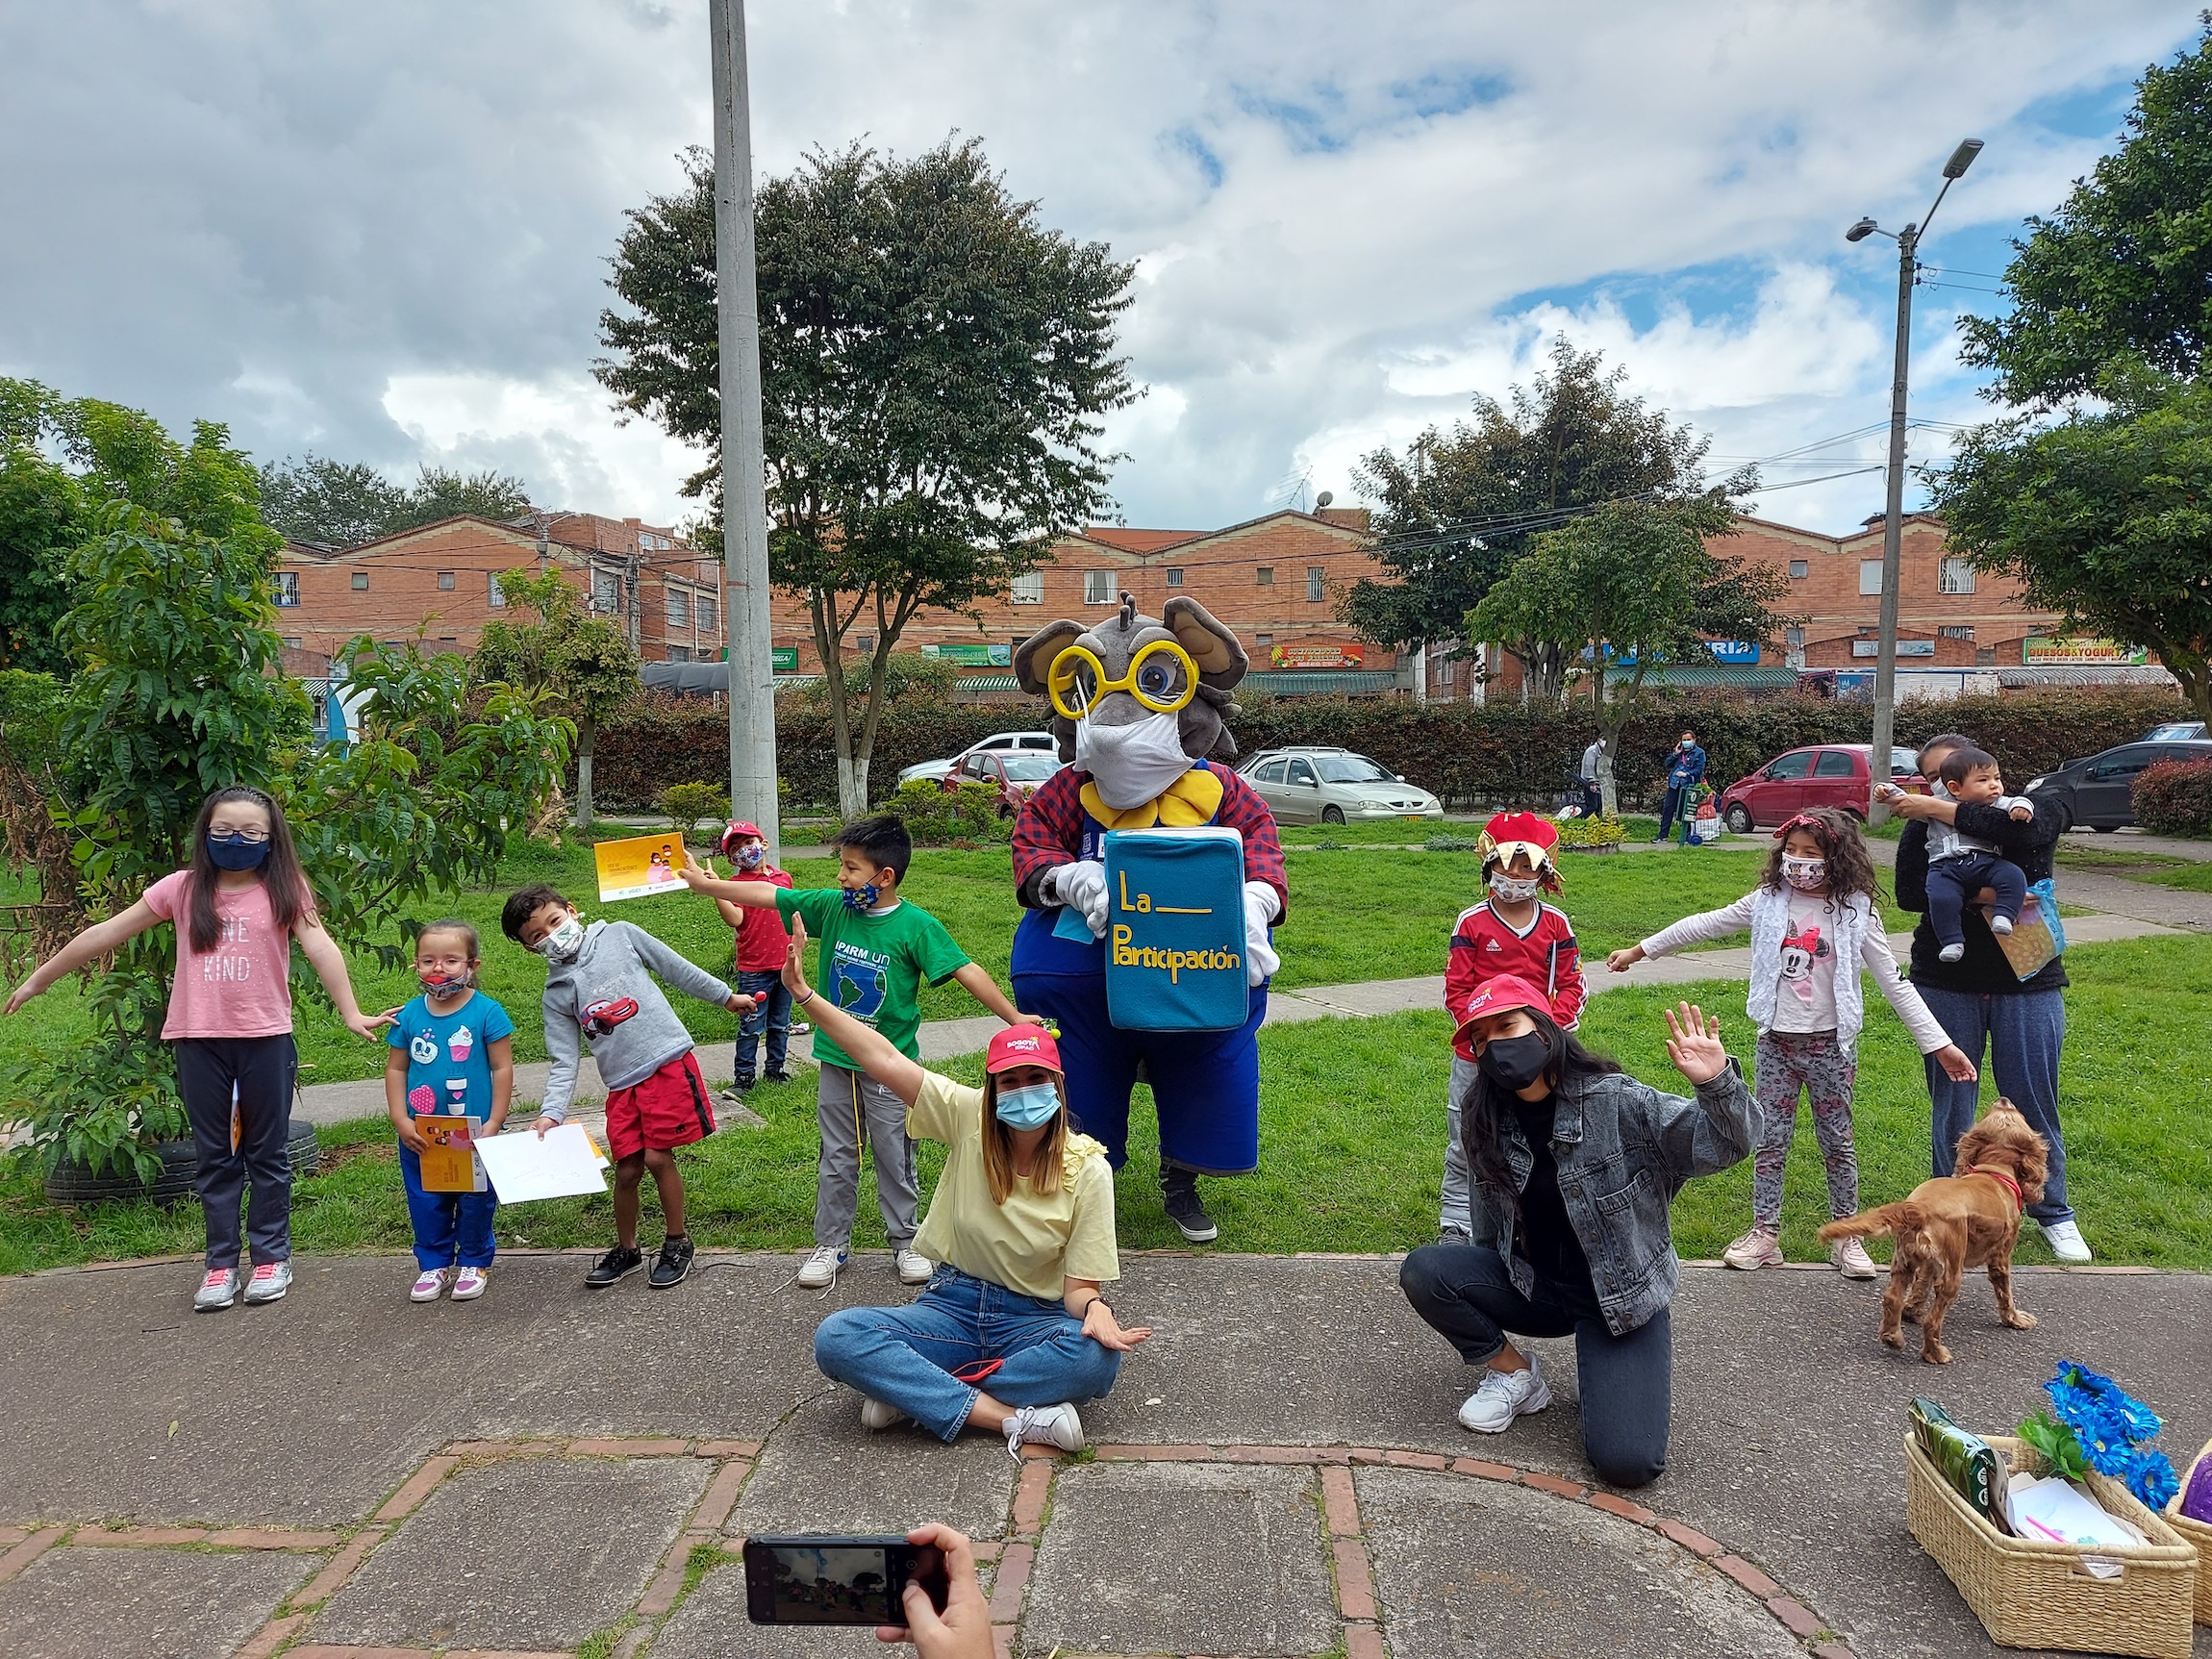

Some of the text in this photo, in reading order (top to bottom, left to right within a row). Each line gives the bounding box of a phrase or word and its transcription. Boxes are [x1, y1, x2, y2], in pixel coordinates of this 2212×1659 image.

[1119, 870, 1152, 914] La
[835, 940, 869, 961] IPARM
[1113, 924, 1241, 984] Participación
[204, 955, 251, 982] KIND
